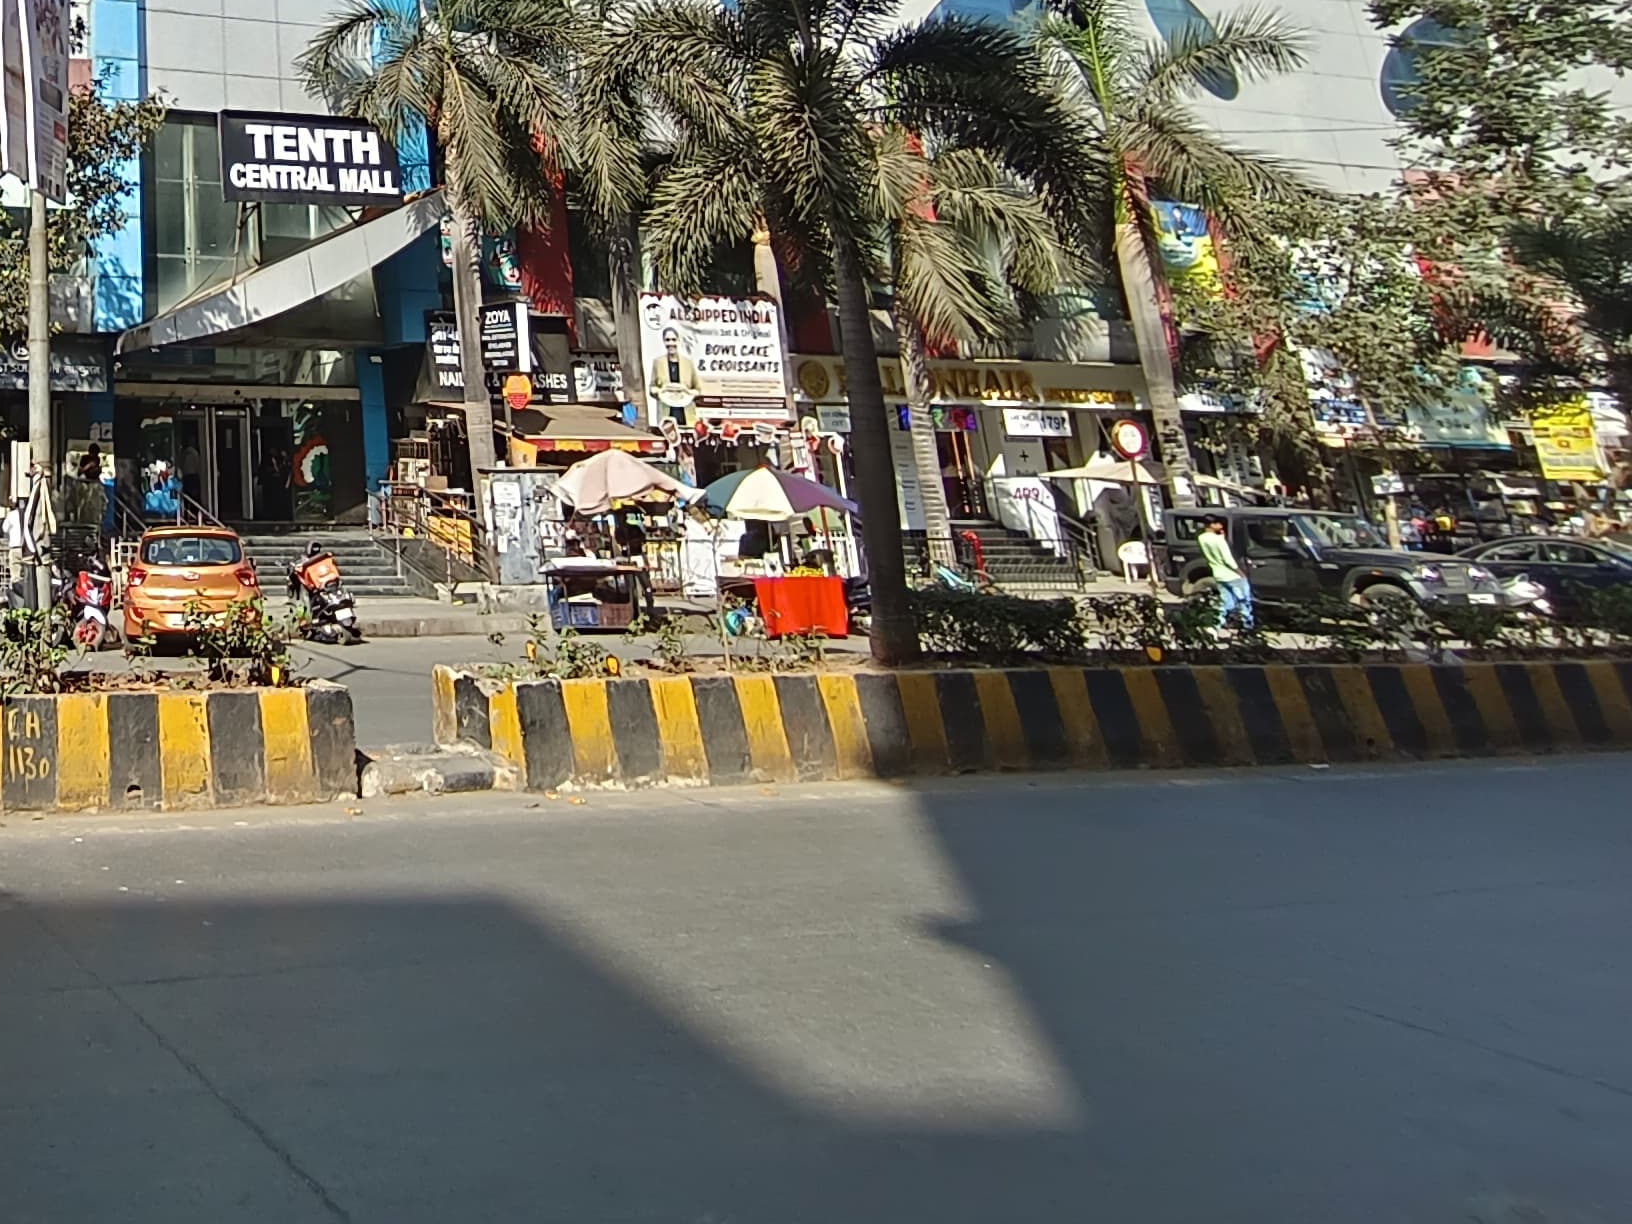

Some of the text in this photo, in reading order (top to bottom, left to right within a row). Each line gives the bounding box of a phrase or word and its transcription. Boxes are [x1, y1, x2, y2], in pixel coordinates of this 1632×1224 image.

[245, 124, 381, 165] TENTH
[229, 162, 400, 195] CENTRAL MALL
[484, 309, 511, 325] ZOYA
[694, 308, 737, 323] DIPPED
[739, 309, 772, 325] INDIA
[705, 342, 770, 357] BOWL CAKE
[697, 359, 780, 373] & CROISSANTS
[439, 371, 466, 387] NAIL
